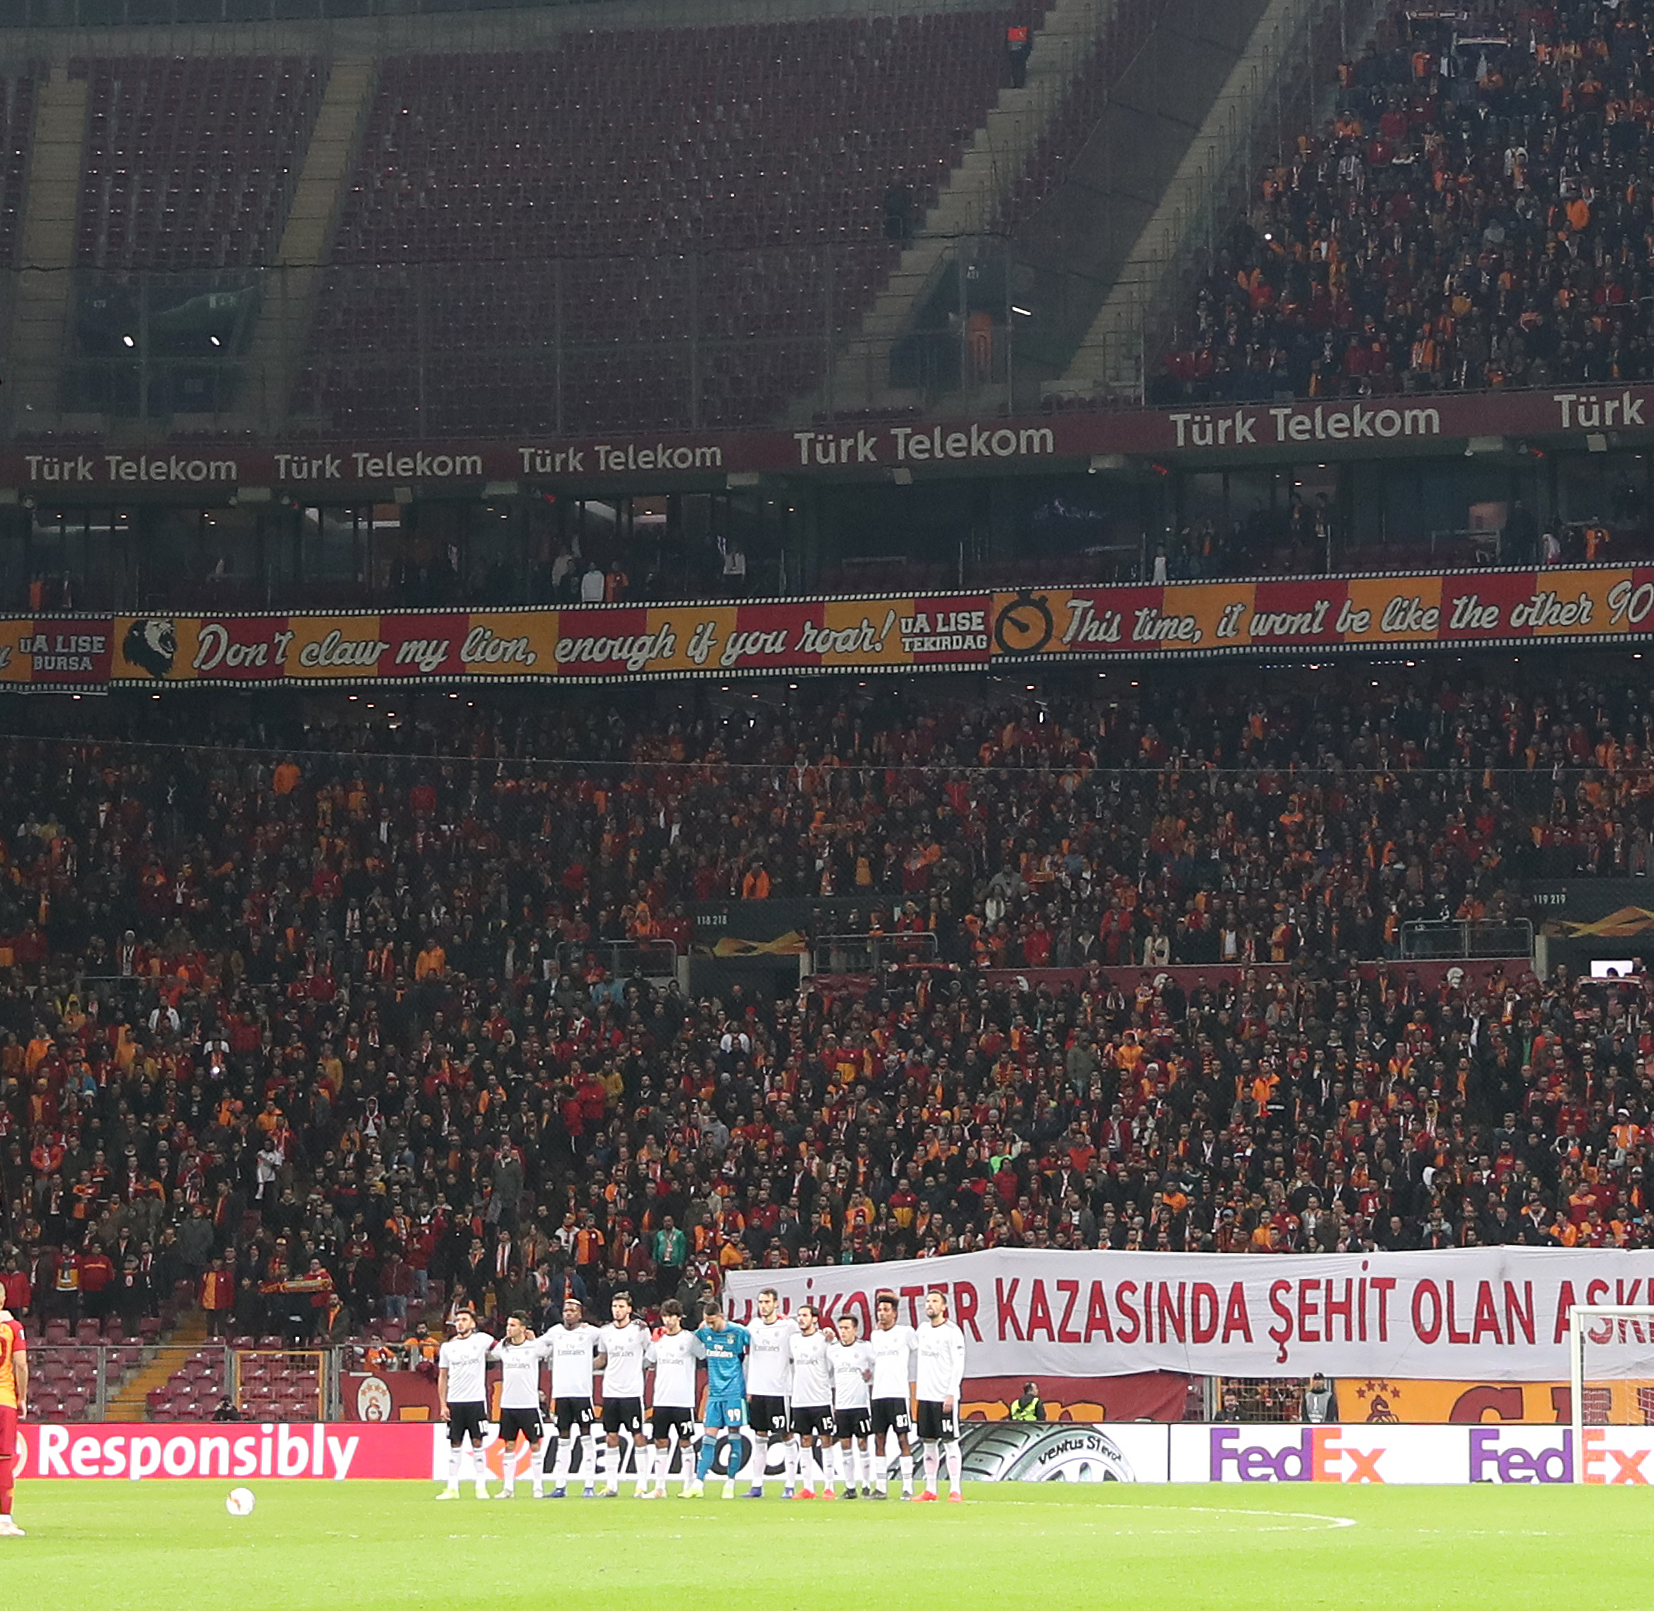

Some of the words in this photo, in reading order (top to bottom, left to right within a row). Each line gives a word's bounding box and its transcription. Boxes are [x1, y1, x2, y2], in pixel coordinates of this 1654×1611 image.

[1554, 391, 1644, 427] Türk
[1169, 410, 1256, 446] Türk
[1270, 404, 1439, 441] Telekom
[518, 447, 583, 472] Türk
[594, 443, 721, 470] Telekom
[794, 430, 877, 464] Türk
[891, 424, 1053, 460] Telekom
[25, 456, 93, 480] Türk
[105, 455, 236, 481] Telekom
[274, 454, 341, 479] Türk
[352, 451, 482, 477] Telekom
[937, 611, 986, 633] LISE
[1062, 599, 1122, 644] This
[1132, 607, 1201, 643] time,
[1216, 603, 1245, 638] it
[1249, 600, 1330, 637] won't
[1335, 599, 1371, 633] be
[1381, 596, 1440, 632] like
[1449, 594, 1499, 630] the
[1510, 592, 1593, 628] other
[1608, 580, 1654, 624] 90
[55, 635, 106, 654] LISE
[192, 623, 294, 671] Don't
[300, 630, 391, 667] claw
[395, 639, 450, 670] my
[462, 626, 536, 665] lion,
[554, 623, 676, 672] enough
[687, 621, 717, 664] if
[720, 630, 788, 667] you
[793, 610, 895, 654] roar!
[901, 634, 988, 652] TEKIRDAG
[33, 655, 94, 671] BURSA
[997, 1278, 1254, 1345] KAZASINDA
[1269, 1259, 1397, 1365] ŞEHİT
[1412, 1278, 1536, 1346] OLAN
[581, 1408, 594, 1423] 61
[632, 1416, 640, 1429] 6
[727, 1408, 741, 1423] 99
[772, 1415, 785, 1429] 97
[820, 1416, 833, 1430] 15
[533, 1423, 541, 1436] 7
[39, 1424, 360, 1481] Responsibly
[1210, 1427, 1387, 1484] FedEx
[1470, 1428, 1651, 1486] FedEx
